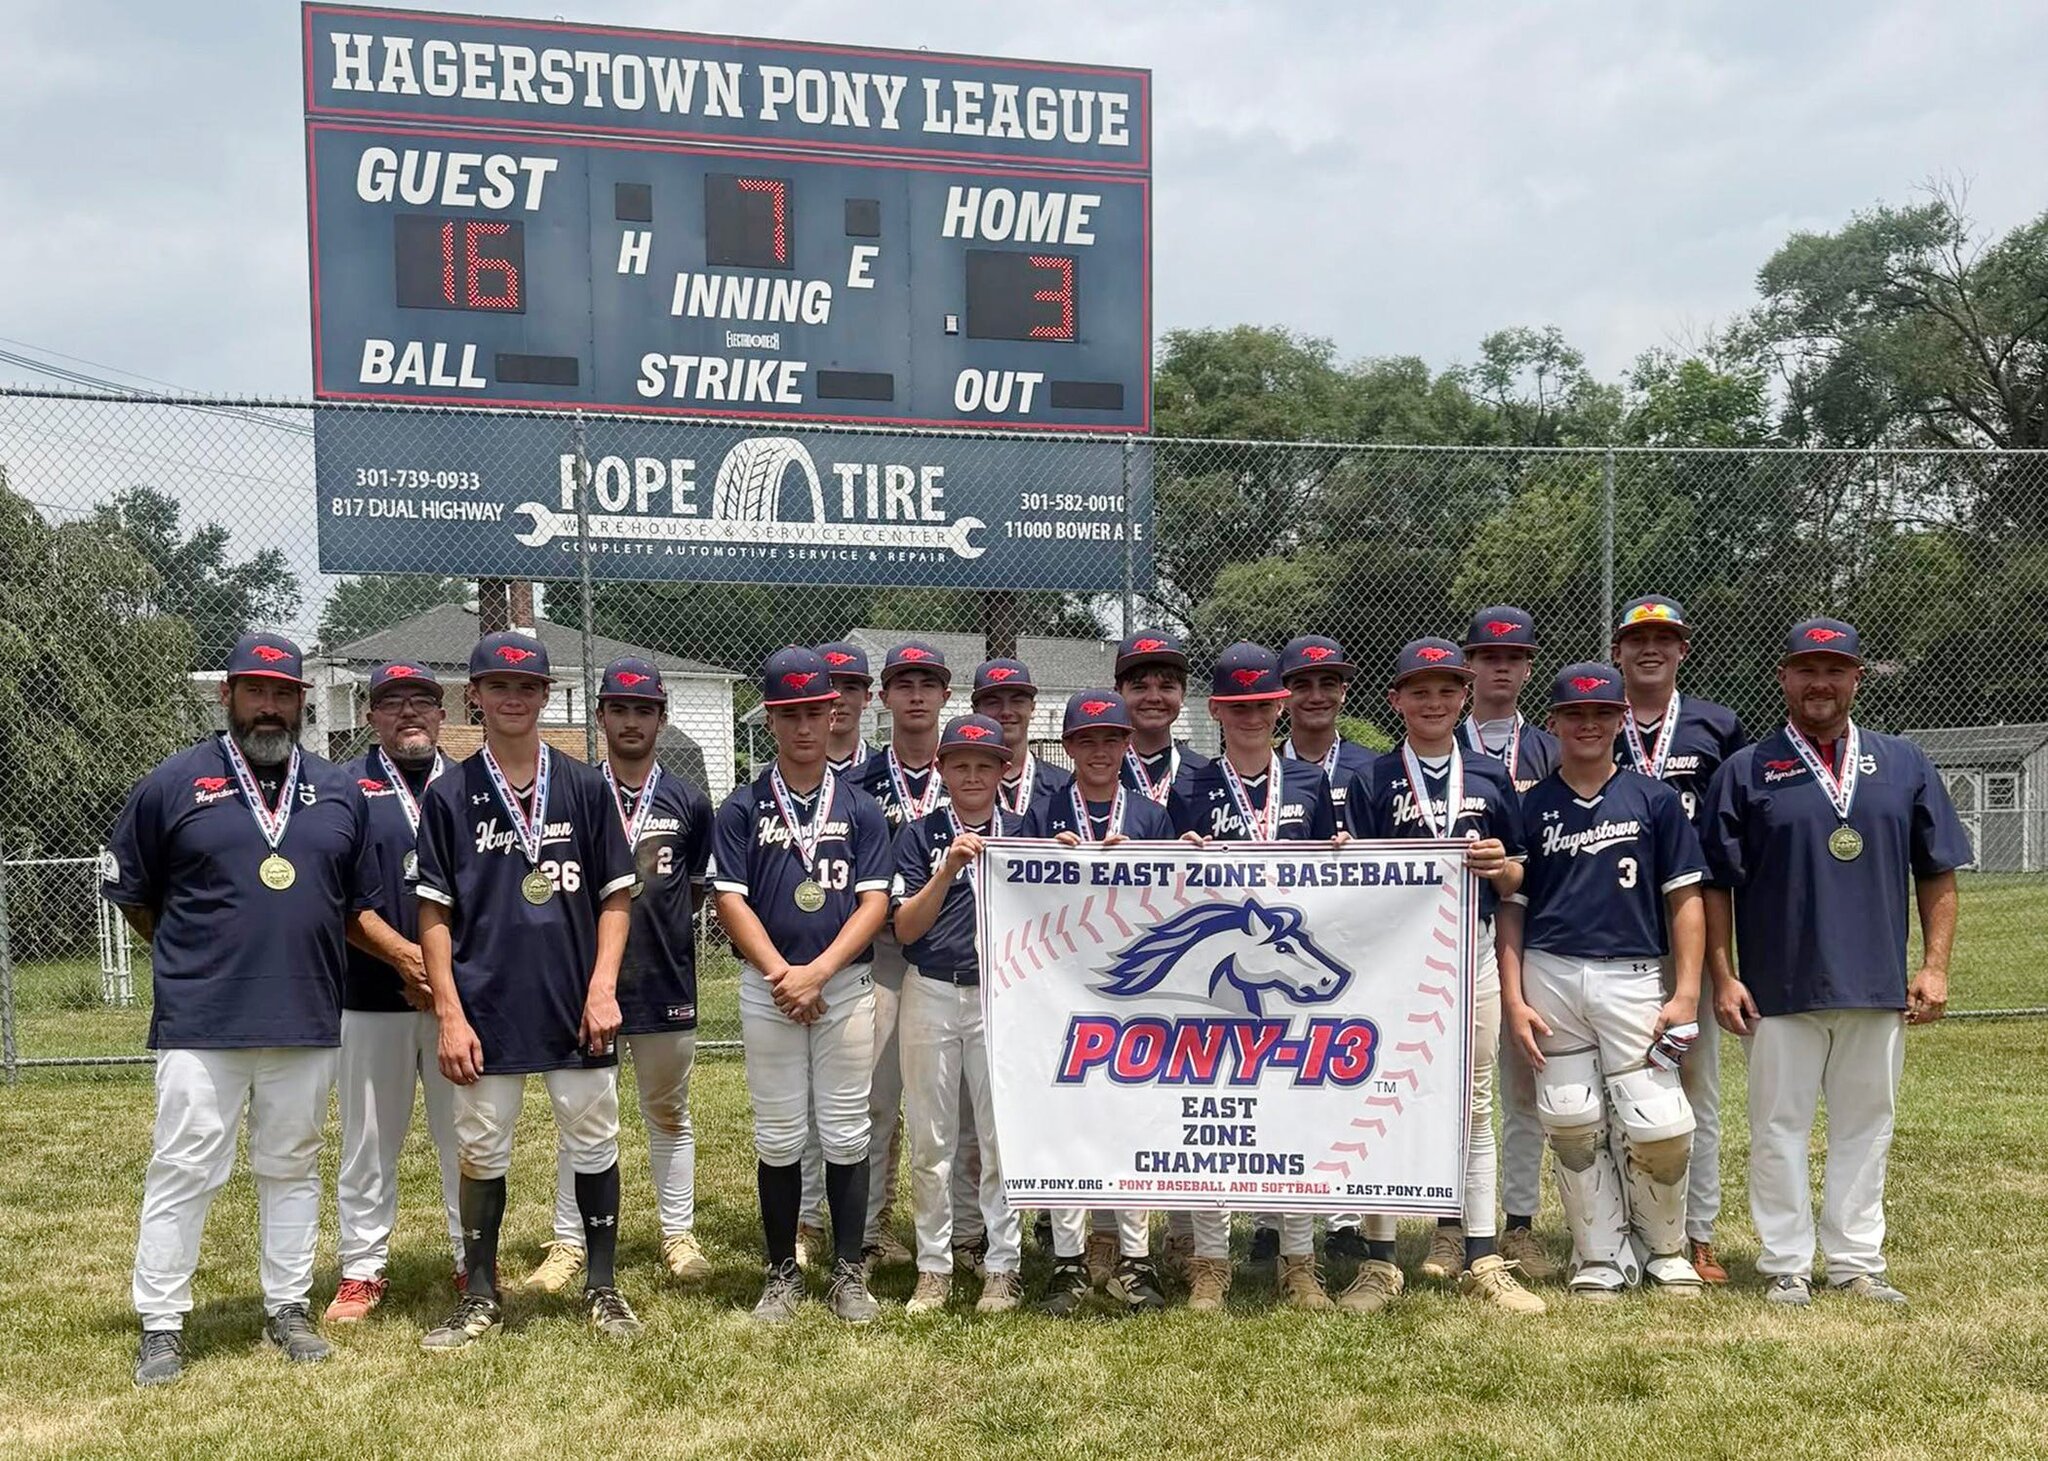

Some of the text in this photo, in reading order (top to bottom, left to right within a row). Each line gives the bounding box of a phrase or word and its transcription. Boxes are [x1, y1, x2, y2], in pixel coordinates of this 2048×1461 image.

[330, 32, 1130, 146] HAGERSTOWN PONY LEAGUE
[356, 146, 559, 211] GUEST
[738, 179, 786, 264] 7
[941, 186, 1101, 246] HOME
[442, 221, 519, 308] 16
[617, 230, 652, 275] H
[847, 245, 880, 289] E
[670, 272, 833, 325] INNING
[1029, 255, 1073, 339] 3
[359, 338, 487, 389] BALL
[636, 352, 807, 404] STRIKE
[953, 368, 1044, 414] OUT
[356, 468, 481, 490] 301-739-0933
[560, 453, 946, 522] POPE TIRE
[332, 497, 505, 521] 817 DUAL HIGHWAY
[563, 519, 708, 536] WREHOUSE
[752, 527, 847, 541] SERVICE
[863, 529, 946, 543] CENTER
[1004, 520, 1143, 541] 11000 BOWER AE
[665, 545, 777, 559] AUTOMOTIVE
[788, 548, 858, 561] SERVICE
[868, 551, 878, 561] &
[888, 551, 947, 563] REPAIR
[1542, 820, 1640, 857] Hagerstown
[540, 860, 580, 892] 26
[656, 846, 674, 875] 2
[817, 858, 849, 890] 13
[1006, 859, 1444, 888] 2026 EAST ZONE BASEBALL
[1618, 857, 1638, 888] 3
[1054, 1013, 1379, 1088] PONY-13
[1375, 1081, 1397, 1094] TM
[1181, 1096, 1258, 1119] EAST
[1183, 1124, 1257, 1147] ZONE
[1135, 1151, 1305, 1176] CHAMPIONS
[1118, 1179, 1154, 1191] PONY
[1157, 1180, 1226, 1192] BASEBALL
[1230, 1181, 1258, 1193] AND
[1261, 1182, 1331, 1195] SOFTBALL
[1346, 1184, 1454, 1198] EAST.PONY.ORG
